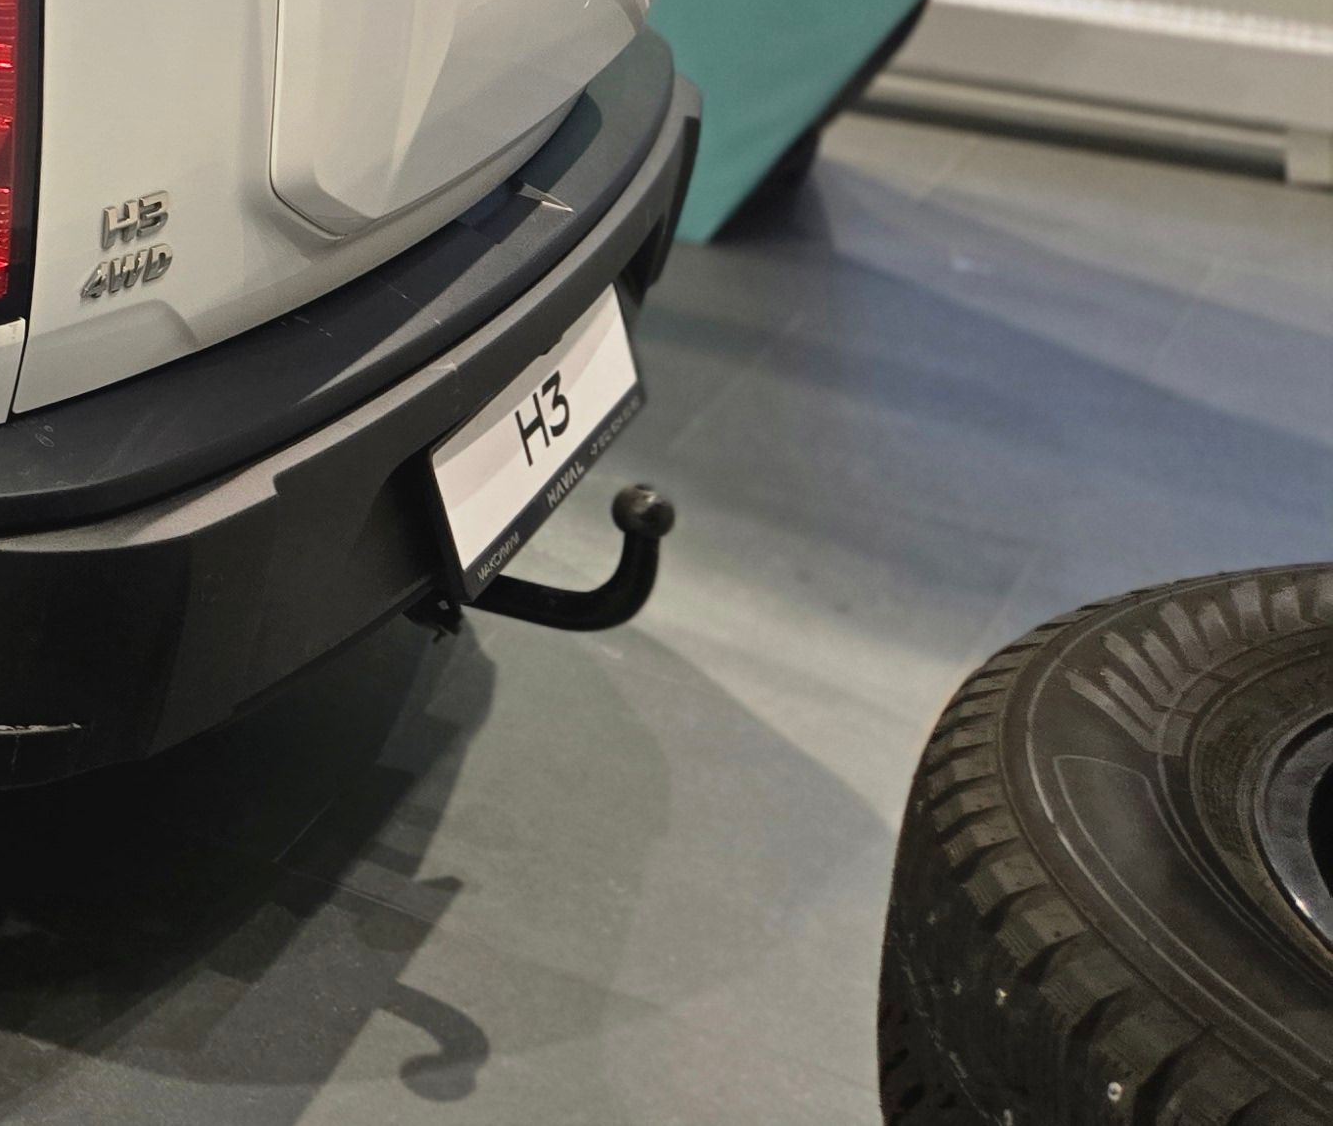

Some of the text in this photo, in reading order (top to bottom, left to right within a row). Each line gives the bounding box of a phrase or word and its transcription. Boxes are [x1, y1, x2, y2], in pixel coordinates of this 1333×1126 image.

[101, 190, 171, 250] H3
[80, 242, 173, 300] 4WD
[515, 370, 572, 466] H3
[545, 461, 586, 510] HAVAL
